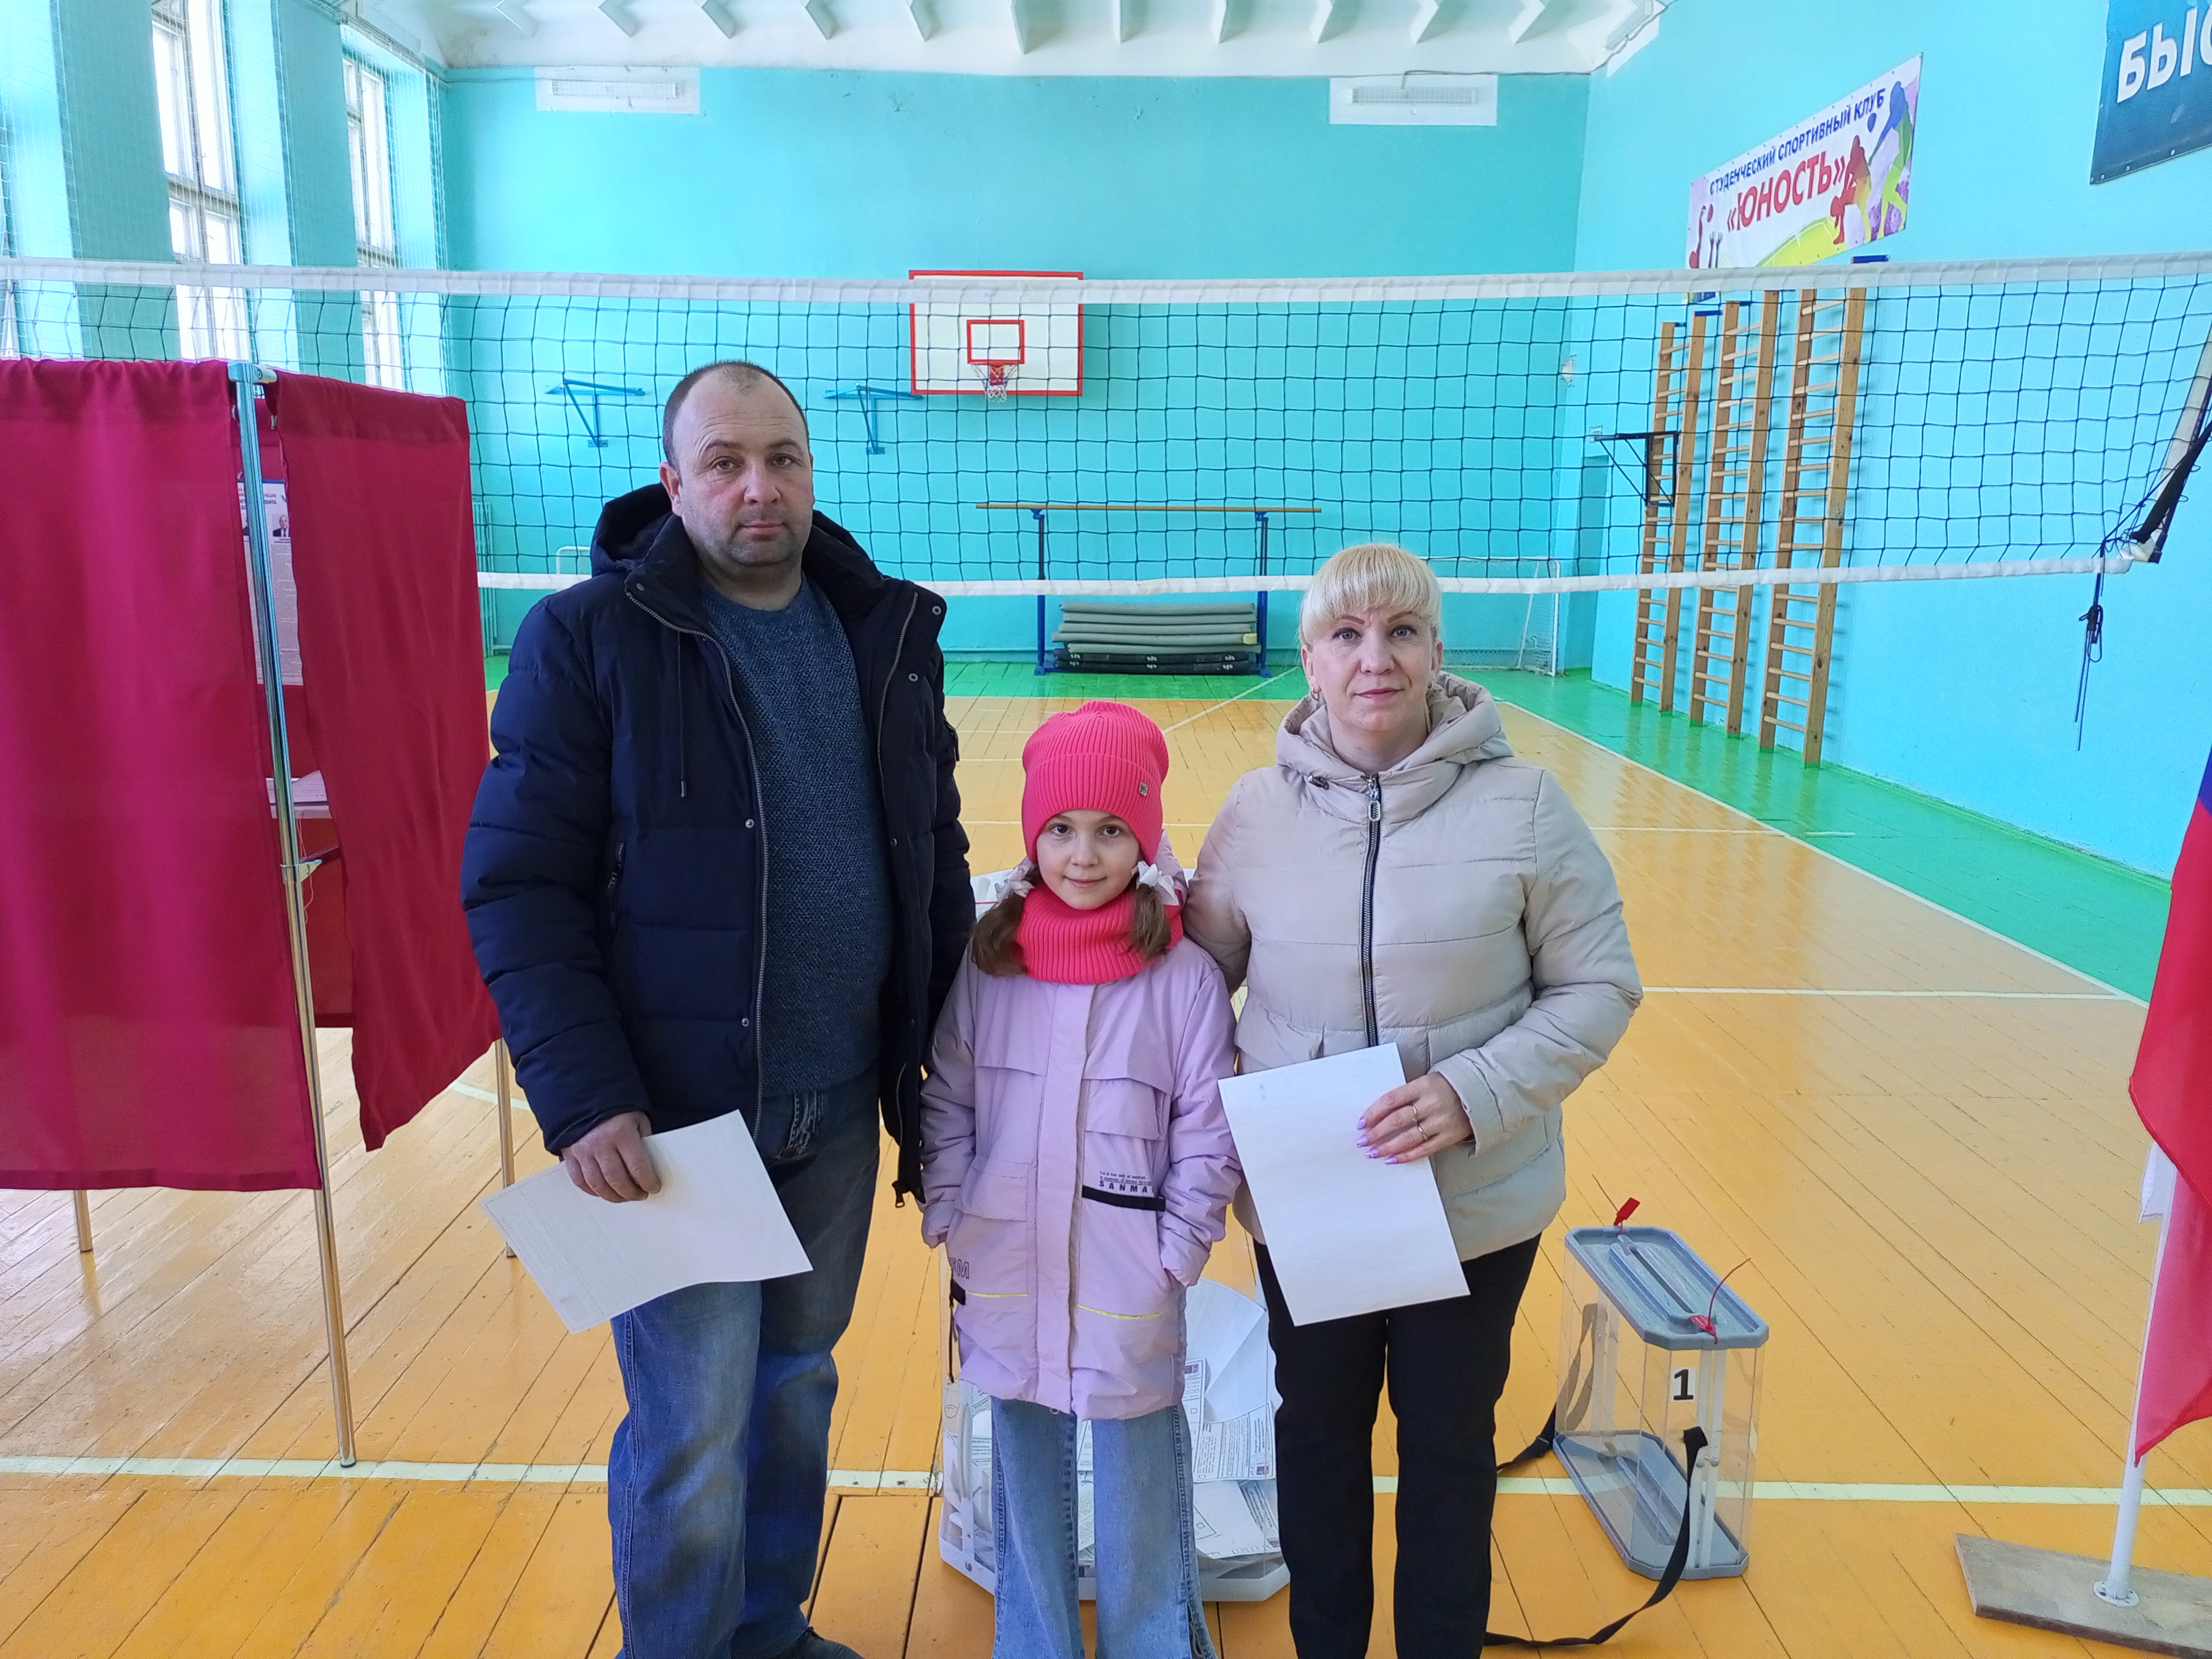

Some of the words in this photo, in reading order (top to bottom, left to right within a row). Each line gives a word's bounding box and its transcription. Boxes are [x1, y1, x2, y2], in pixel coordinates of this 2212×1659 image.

[1709, 145, 1777, 195] СТУДЕНЧЕСКИЙ
[1778, 105, 1851, 161] СПОРТИВНЫЙ
[1854, 88, 1886, 122] КЛУБ
[1726, 151, 1846, 232] «ЮНОСТЬ»
[1099, 1180, 1148, 1193] SANMA
[1673, 1369, 1694, 1400] 1
